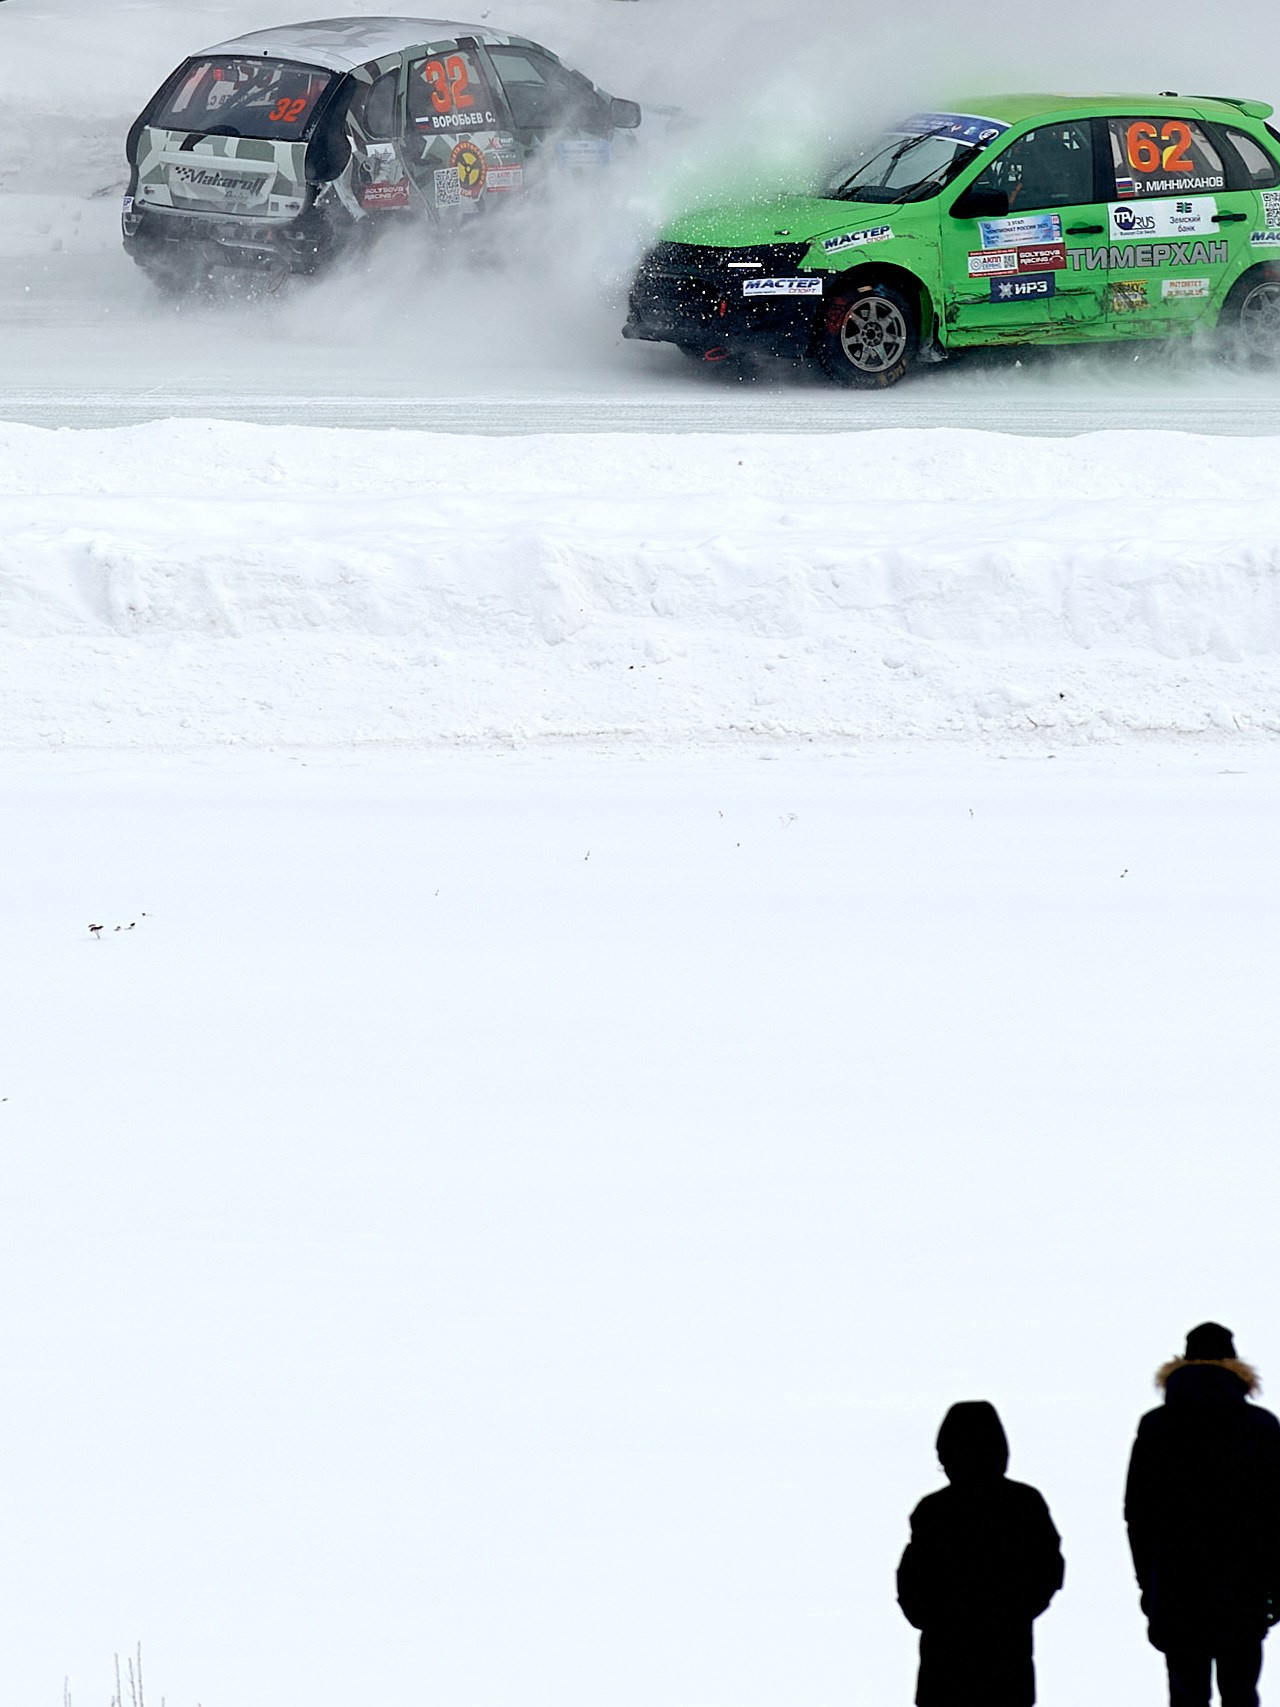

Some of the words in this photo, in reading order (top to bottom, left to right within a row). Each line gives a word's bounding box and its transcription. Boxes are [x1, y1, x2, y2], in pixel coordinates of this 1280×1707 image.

[425, 56, 474, 113] 32
[269, 97, 306, 122] 32
[432, 114, 483, 128] ВОРОБЬЕВ
[485, 112, 496, 123] С.
[1126, 121, 1194, 172] 62
[1169, 214, 1201, 224] Земский
[824, 225, 890, 249] МАСТЕР
[1066, 240, 1228, 271] ТИМЕРХАН
[745, 279, 821, 290] МАСТЕР
[1014, 281, 1048, 295] ИРЗ
